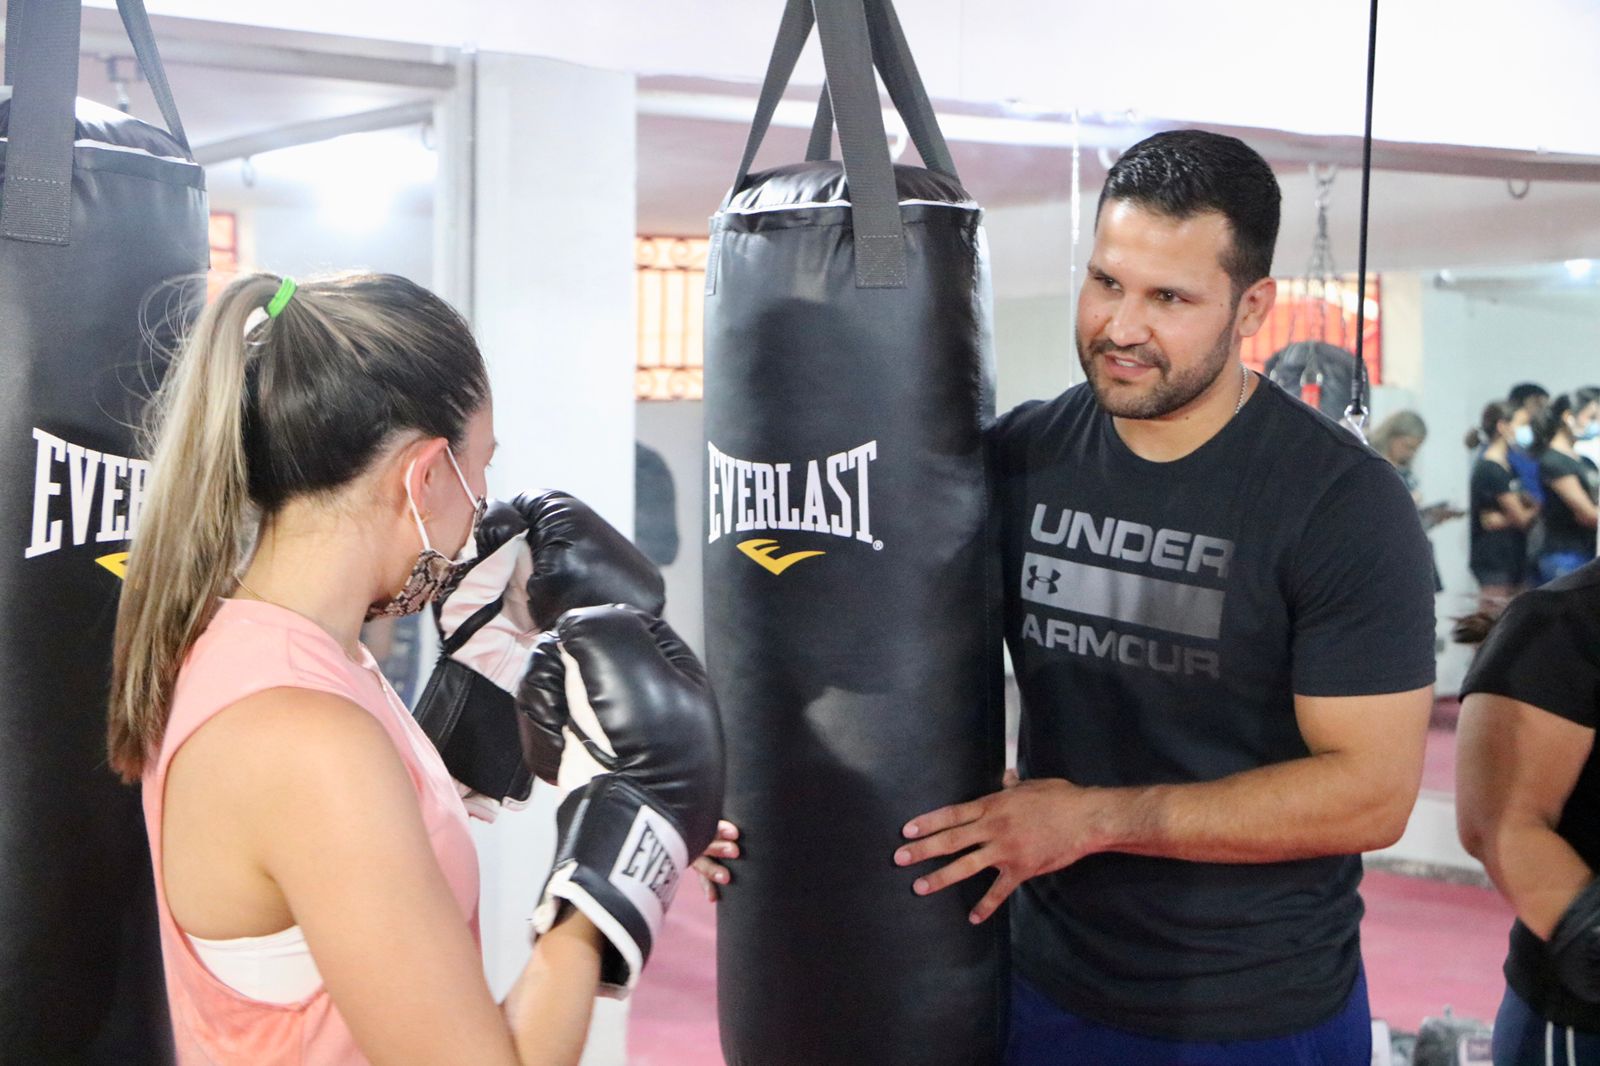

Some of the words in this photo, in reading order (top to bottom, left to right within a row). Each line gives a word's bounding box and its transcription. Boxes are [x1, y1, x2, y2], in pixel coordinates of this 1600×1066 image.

[708, 440, 877, 544] EVERLAST
[1031, 503, 1236, 578] UNDER
[1022, 613, 1220, 679] ARMOUR
